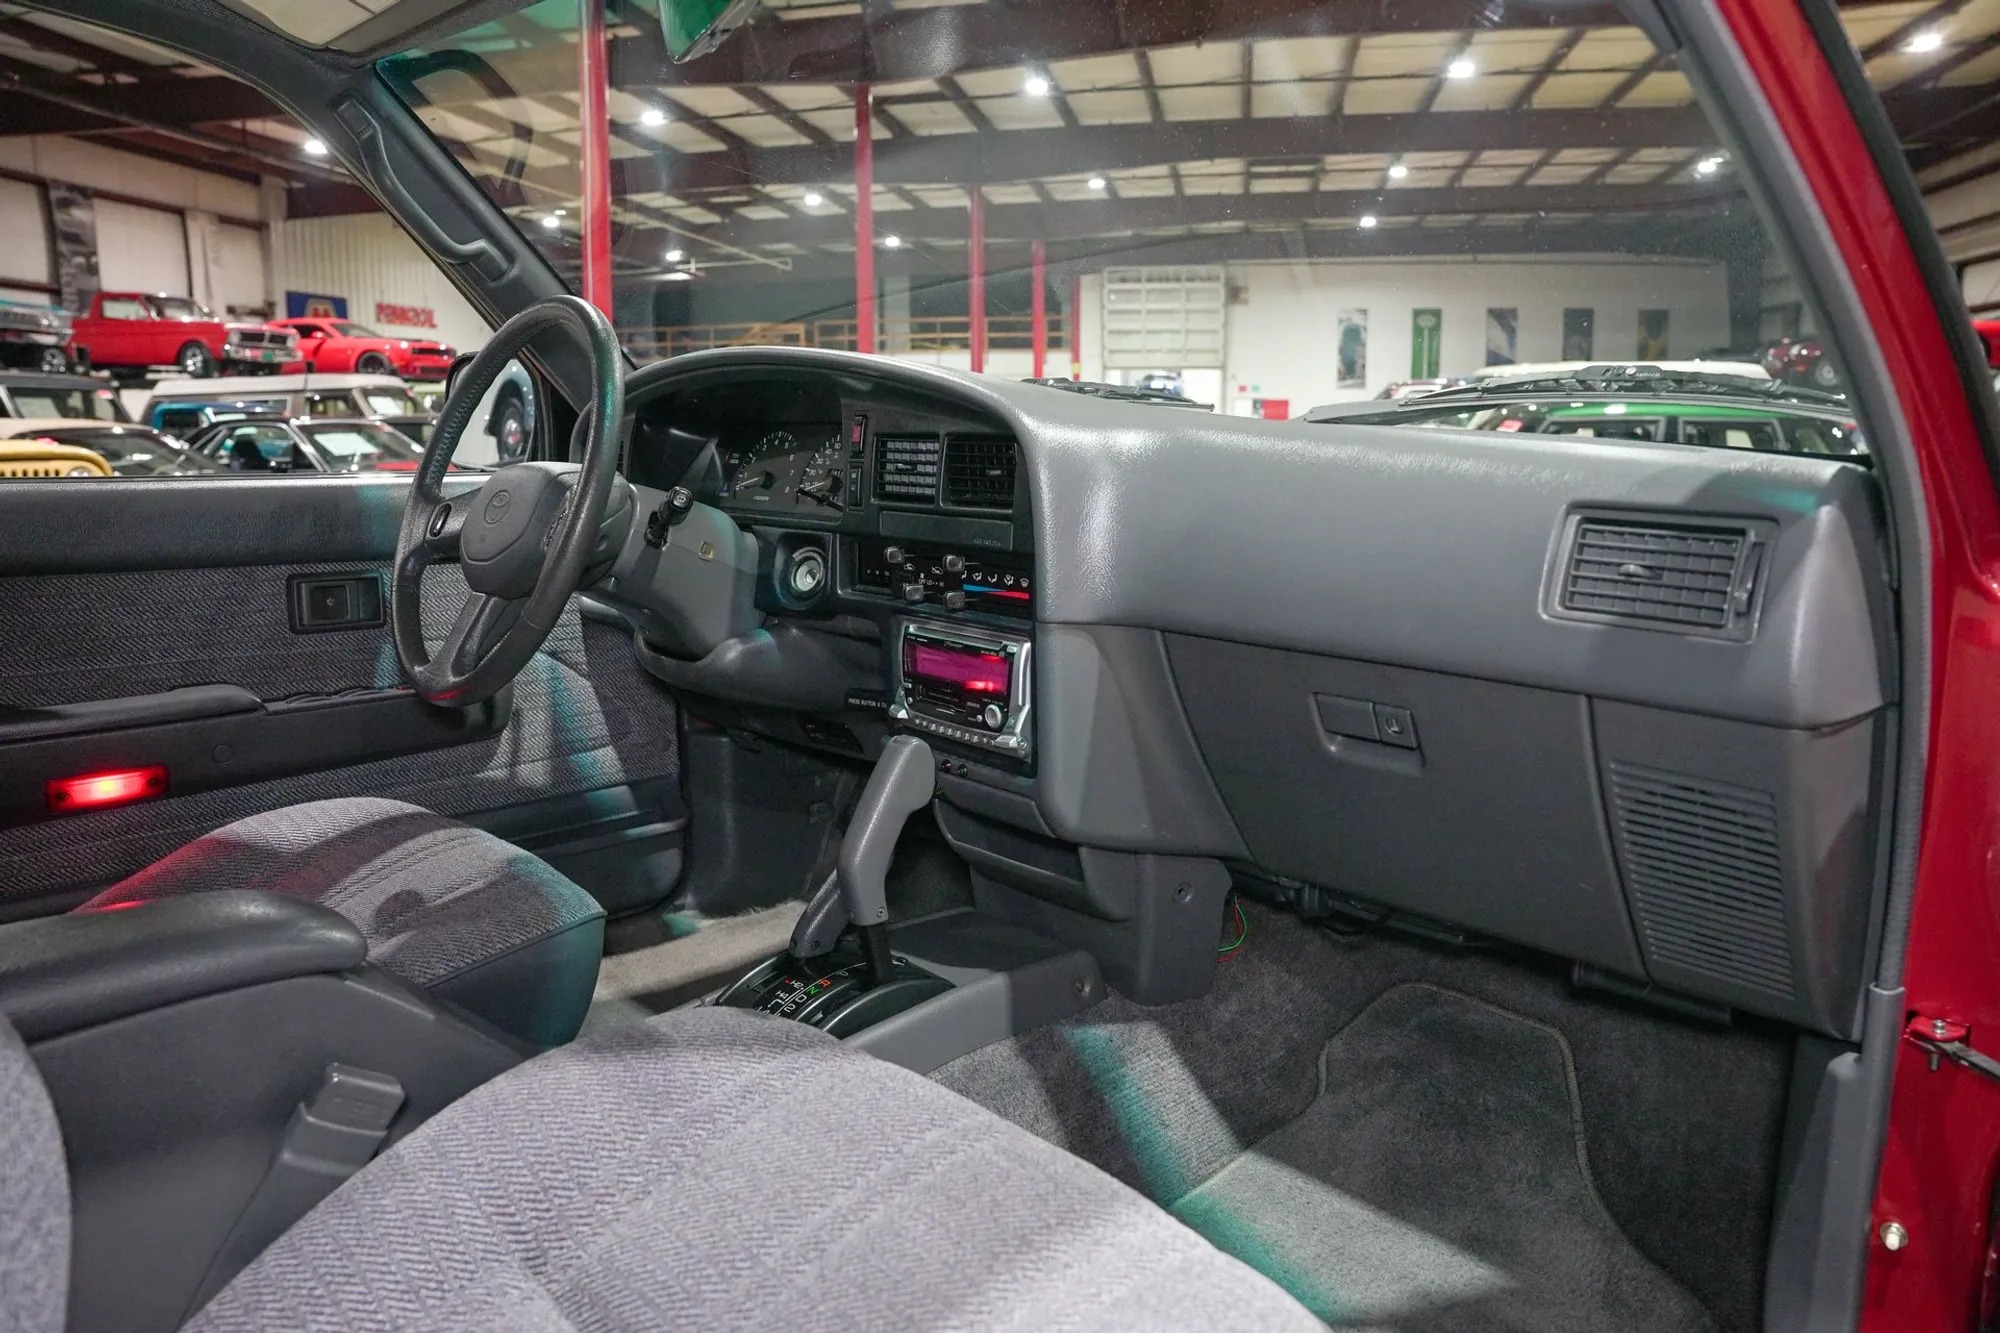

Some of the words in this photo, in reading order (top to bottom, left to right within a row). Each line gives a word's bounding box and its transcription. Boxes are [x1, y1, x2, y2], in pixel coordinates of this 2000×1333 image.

[819, 979, 831, 987] R
[807, 987, 819, 995] N
[795, 994, 807, 1003] D
[784, 1003, 796, 1013] 2
